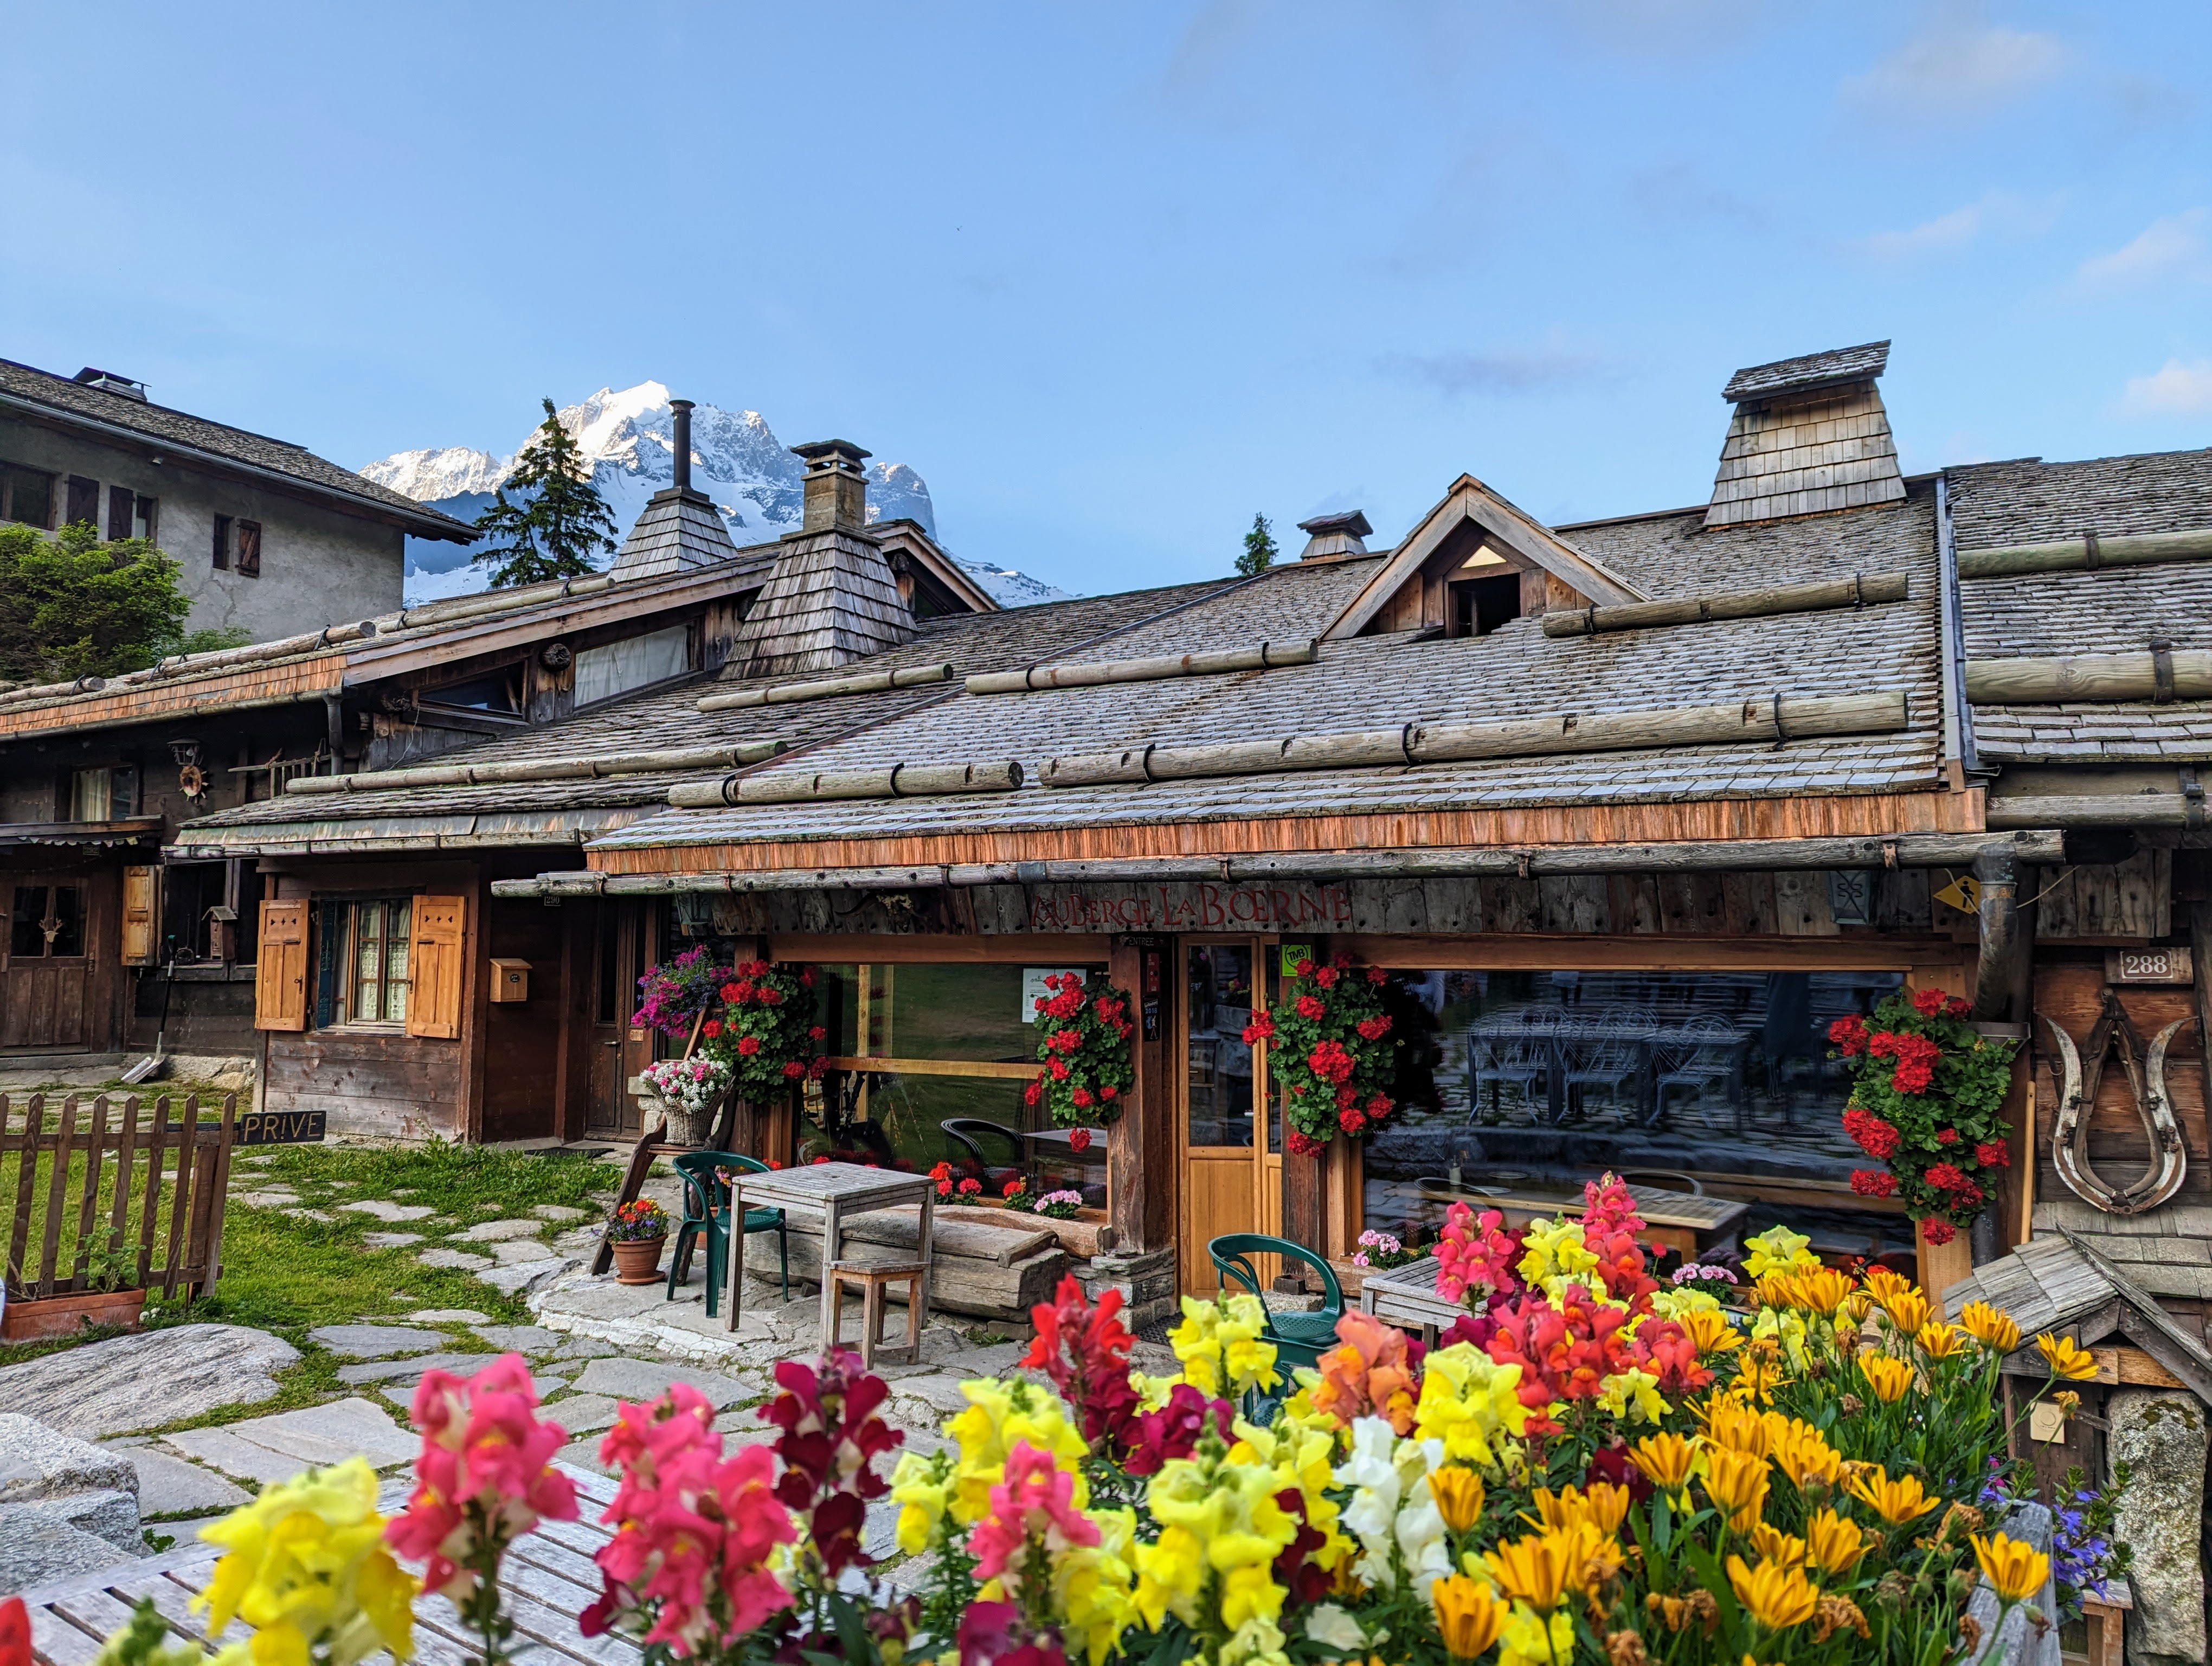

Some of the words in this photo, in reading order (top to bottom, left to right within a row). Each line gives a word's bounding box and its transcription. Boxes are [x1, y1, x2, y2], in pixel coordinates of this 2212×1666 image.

[546, 896, 560, 904] 290
[1287, 948, 1306, 962] TMB
[2125, 955, 2168, 973] 288
